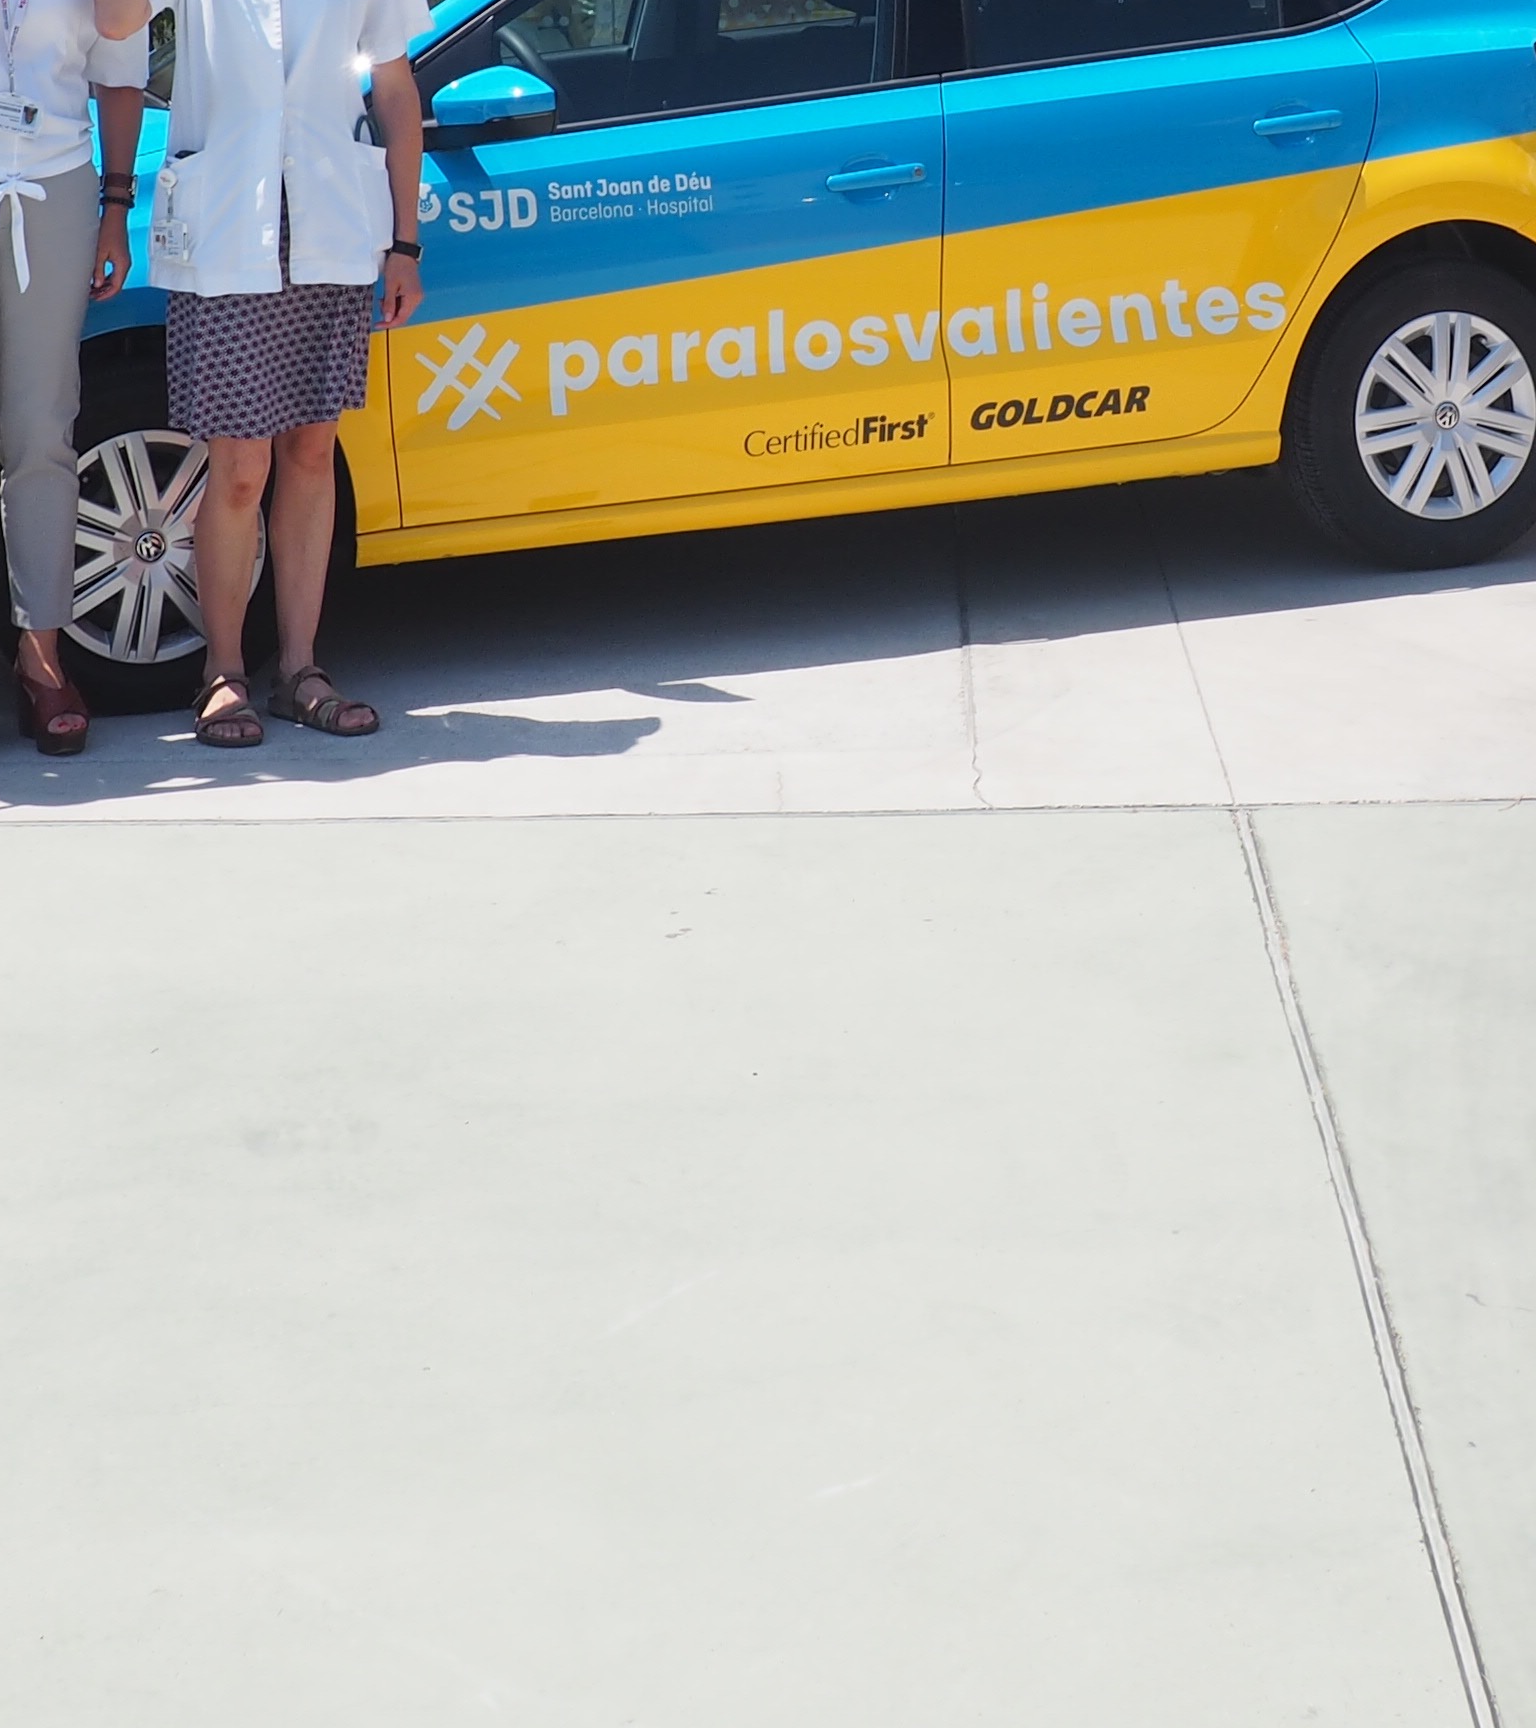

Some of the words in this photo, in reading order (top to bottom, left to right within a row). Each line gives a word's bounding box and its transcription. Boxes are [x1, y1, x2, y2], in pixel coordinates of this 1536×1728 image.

[547, 181, 593, 200] Sant
[596, 177, 644, 197] Joan
[648, 174, 671, 193] de
[675, 171, 712, 191] Déu
[447, 188, 538, 233] SJD
[549, 202, 634, 223] Barcelona
[647, 195, 713, 218] Hospital
[970, 385, 1151, 432] GOLDCAR
